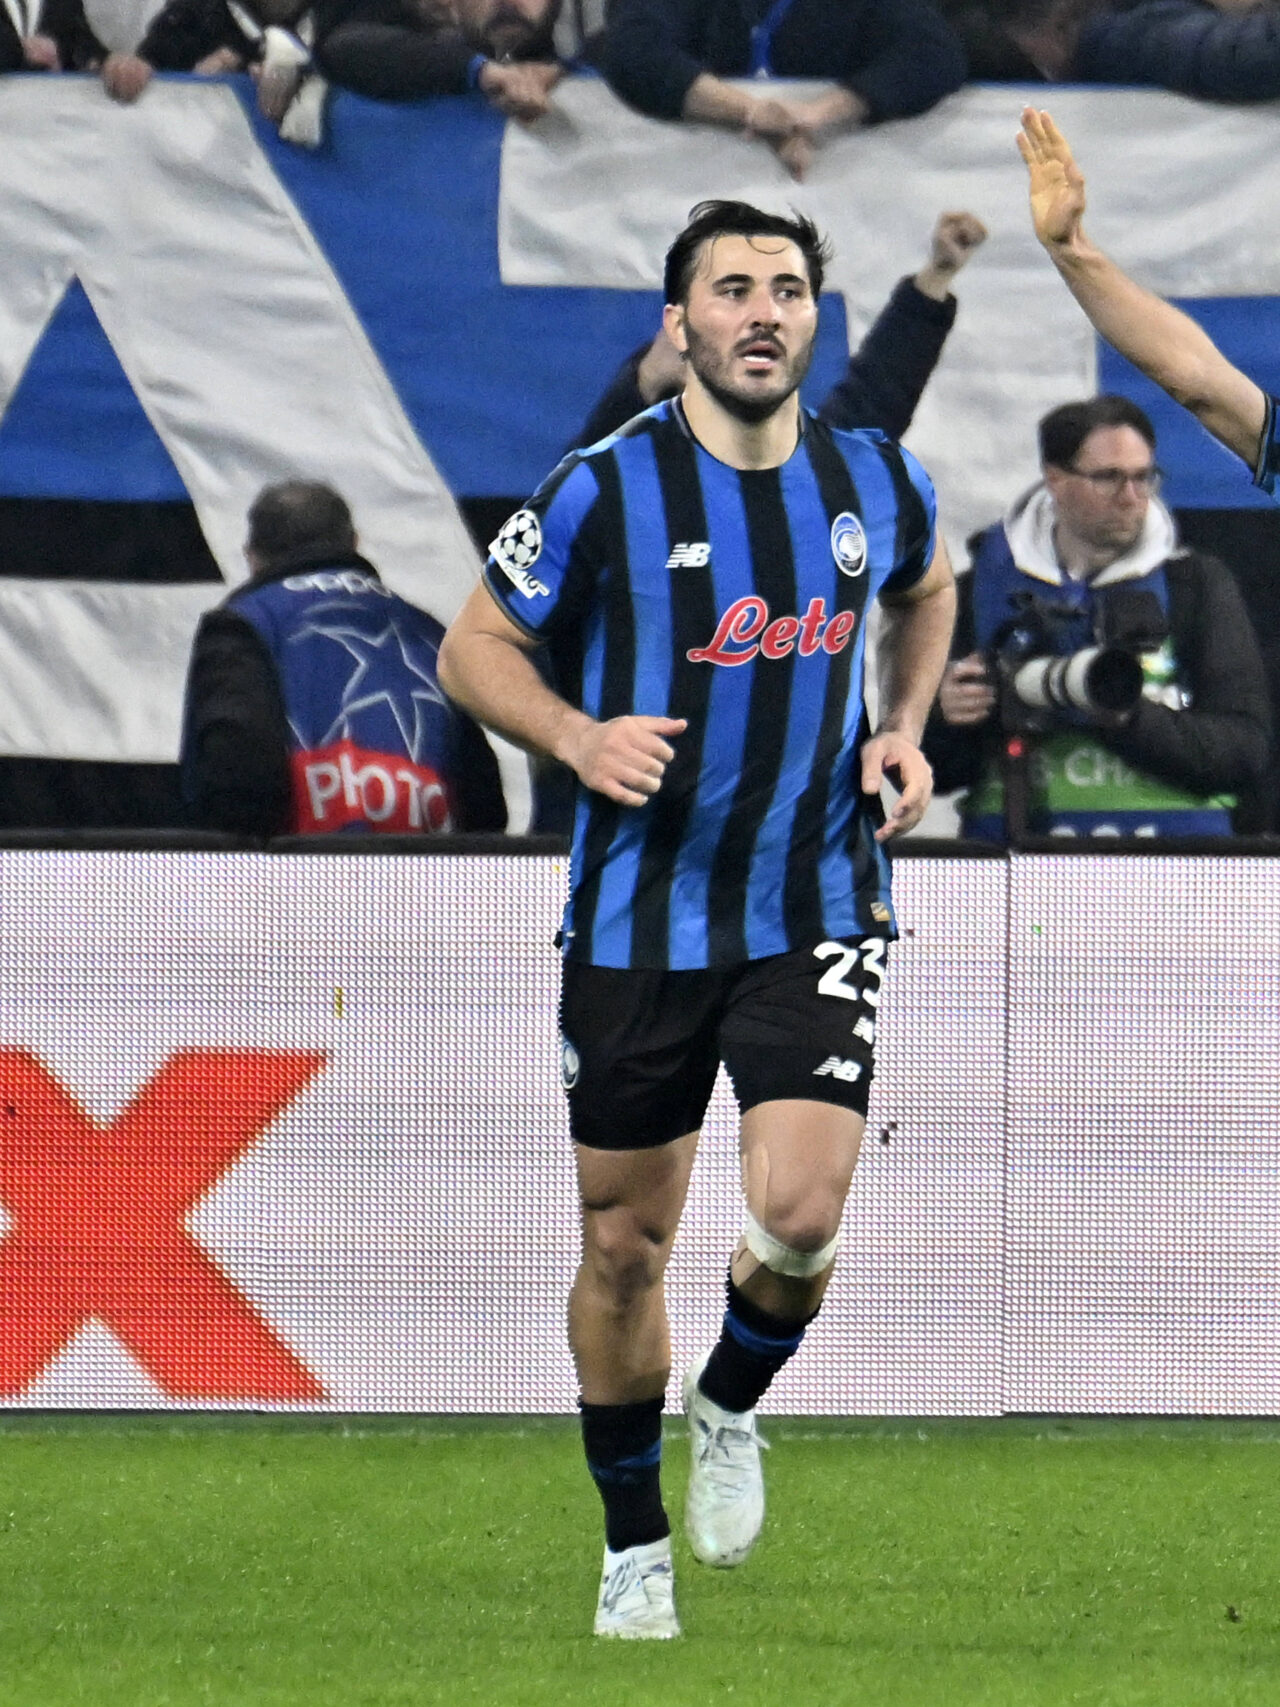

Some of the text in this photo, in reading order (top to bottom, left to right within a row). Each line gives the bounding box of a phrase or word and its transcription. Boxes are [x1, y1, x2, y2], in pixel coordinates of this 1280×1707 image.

[686, 596, 855, 667] Lete
[813, 937, 886, 1008] 23
[0, 1045, 330, 1402] X
